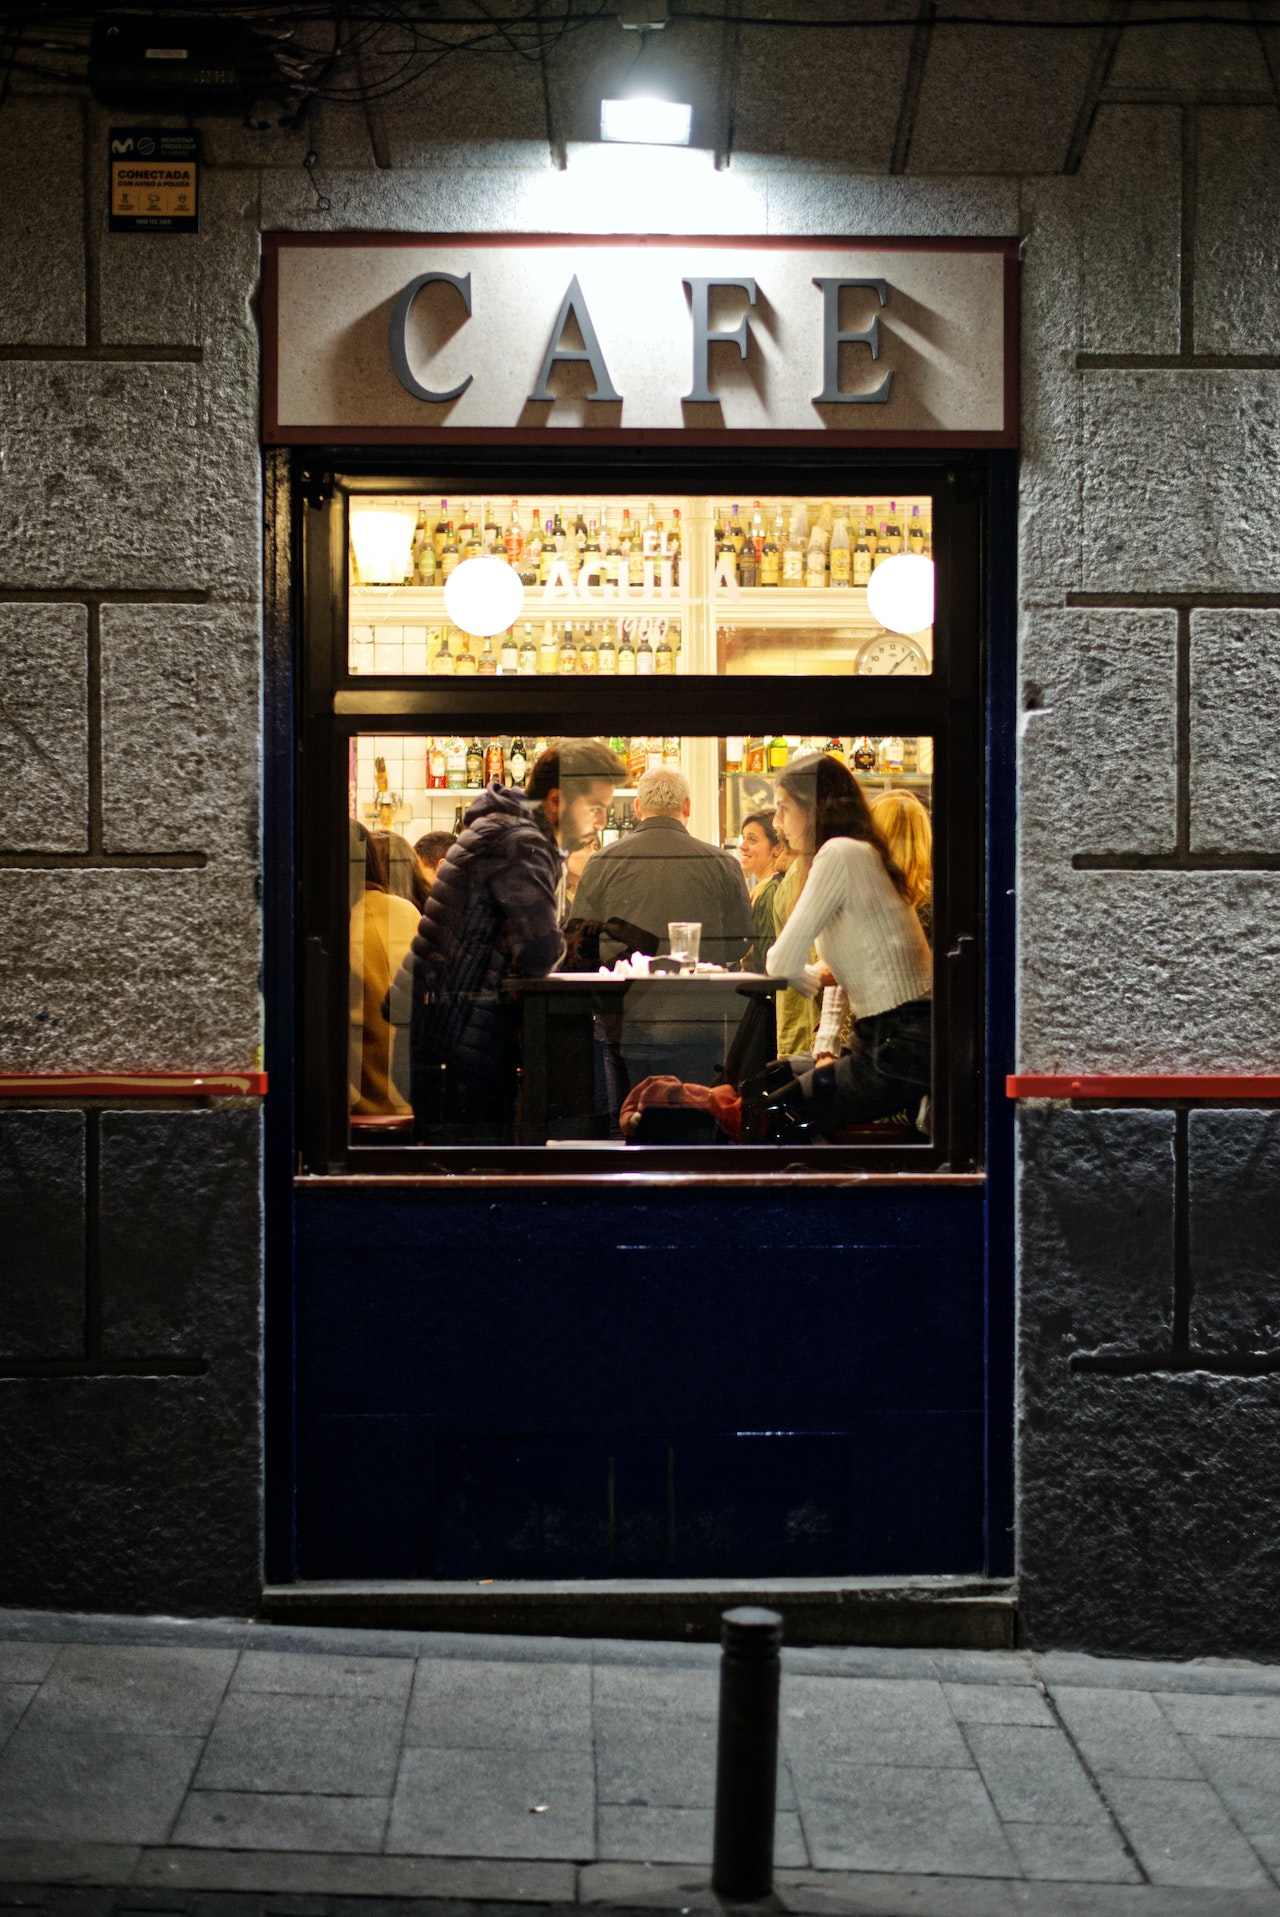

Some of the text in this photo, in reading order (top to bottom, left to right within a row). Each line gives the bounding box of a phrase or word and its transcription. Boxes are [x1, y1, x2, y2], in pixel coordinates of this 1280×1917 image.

[117, 170, 190, 179] CONECTADA
[388, 271, 894, 404] CAFE
[643, 531, 675, 556] EL
[543, 554, 741, 604] ÁGUILA
[615, 616, 669, 641] 1900
